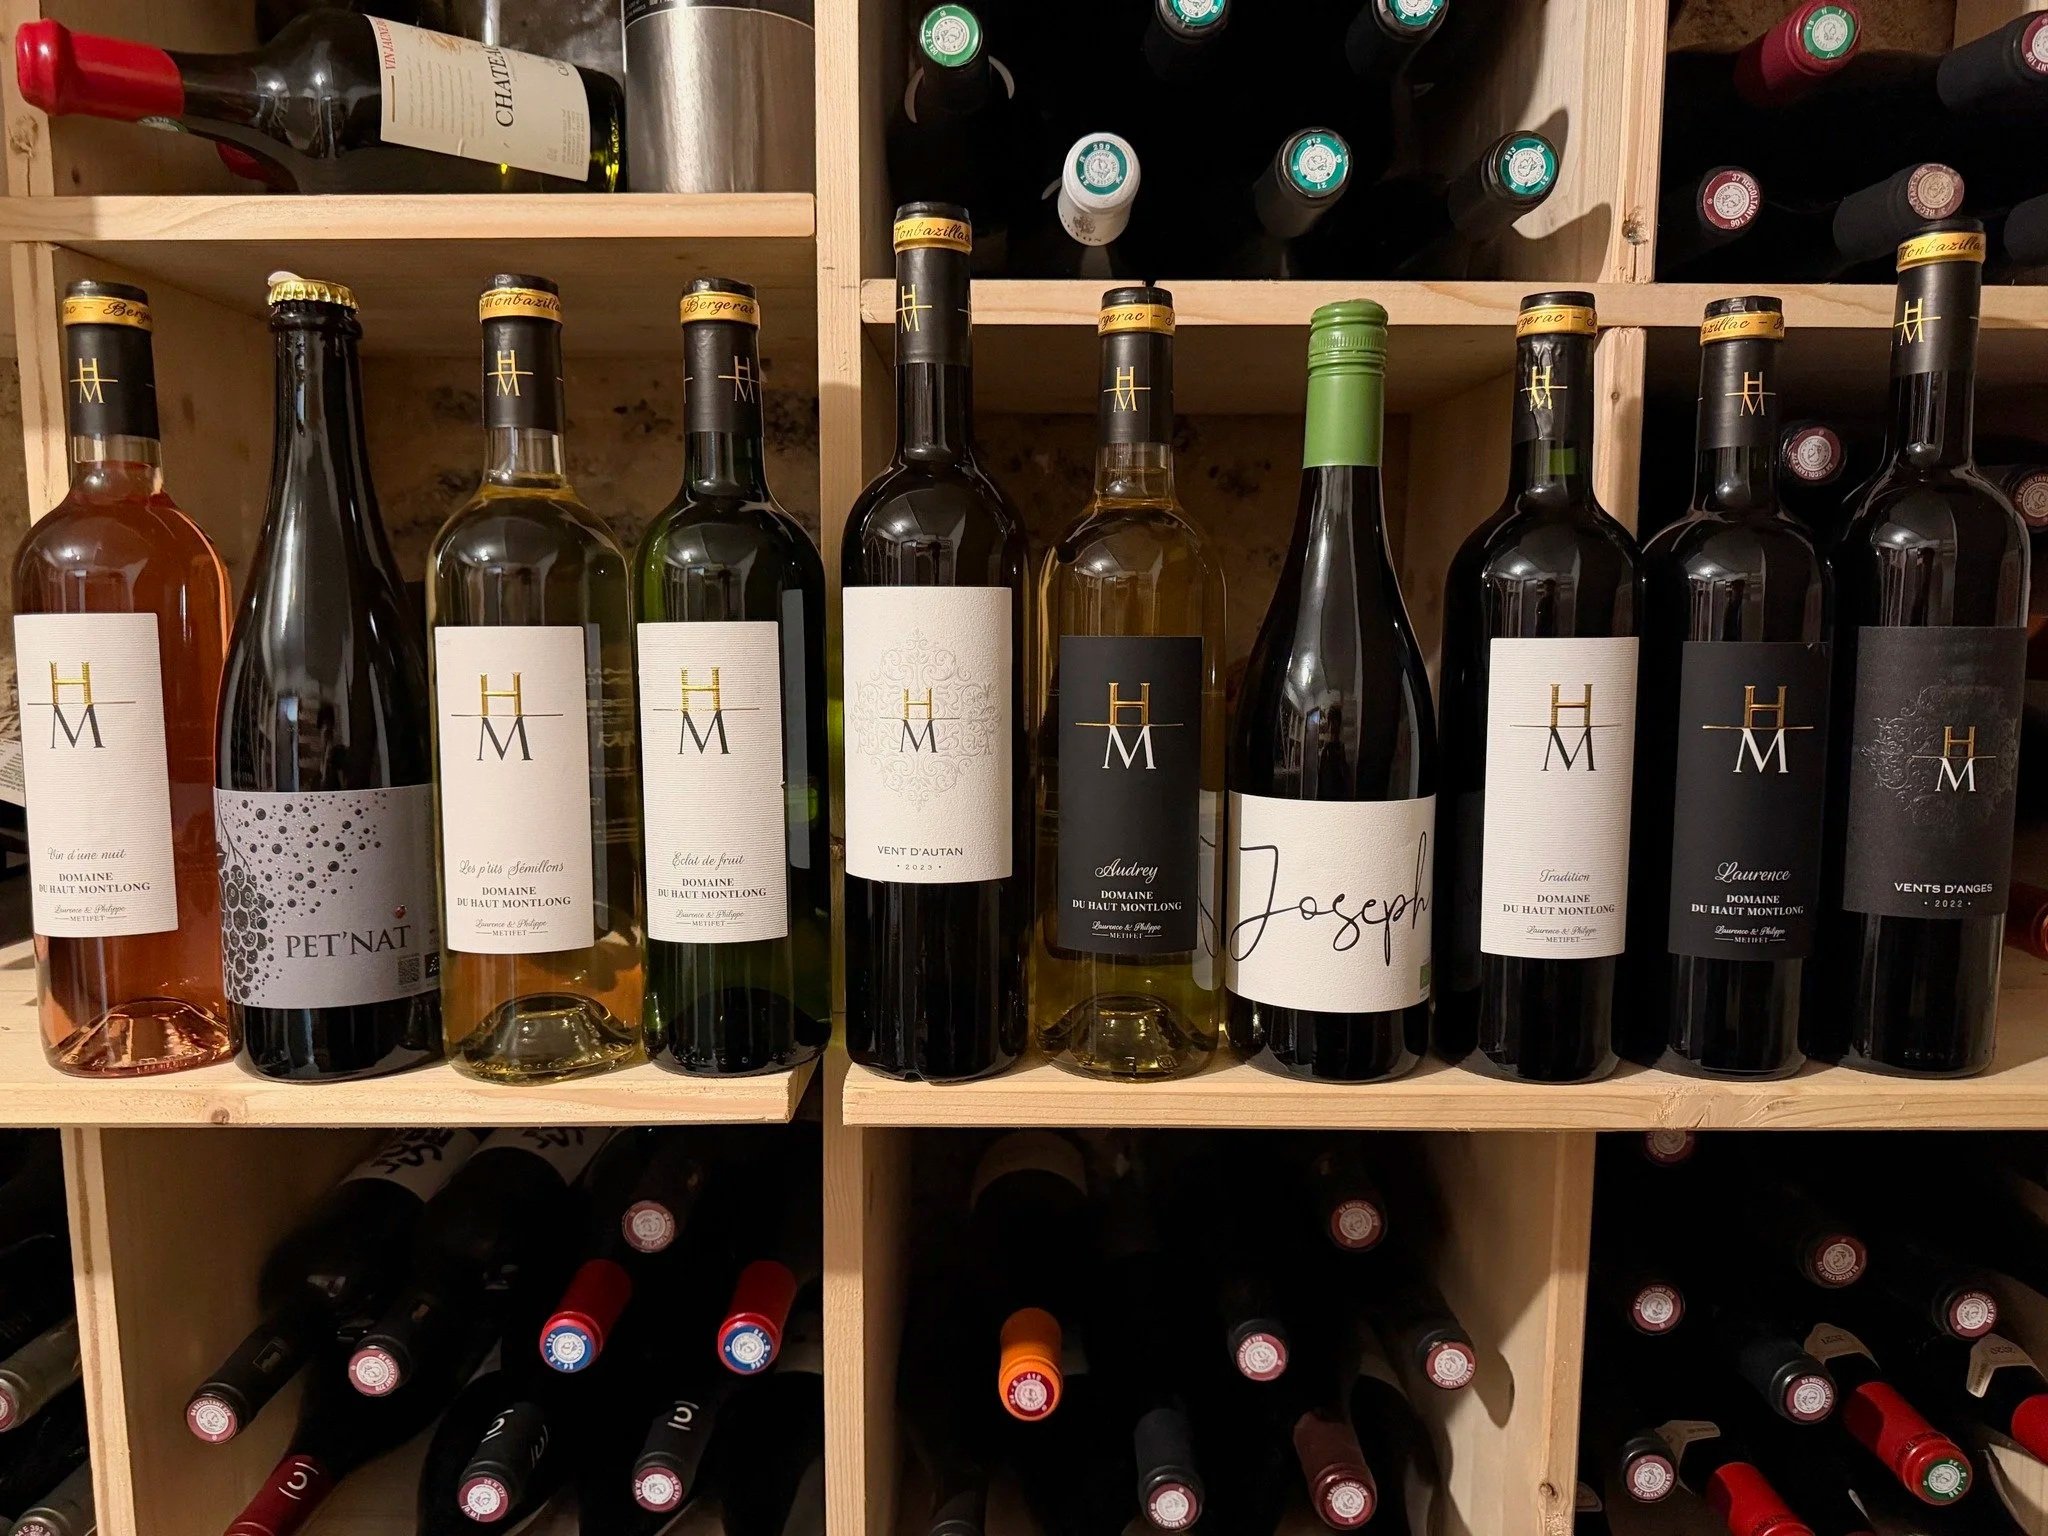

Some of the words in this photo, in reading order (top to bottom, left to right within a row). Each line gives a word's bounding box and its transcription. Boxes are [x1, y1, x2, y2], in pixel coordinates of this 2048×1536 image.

[1740, 177, 1758, 221] RECOLTANT
[685, 296, 755, 316] Bergerac
[101, 848, 126, 860] nuit
[877, 845, 906, 857] VENT
[910, 846, 964, 857] D'AUTAN
[459, 859, 476, 875] Les
[702, 855, 716, 866] de
[715, 852, 746, 870] fruit
[905, 863, 934, 871] 2023
[59, 872, 114, 882] DOMAINE
[1094, 858, 1159, 884] Audrey
[1539, 868, 1590, 883] Tradition
[1714, 861, 1791, 883] Laurence
[39, 884, 47, 893] DU
[49, 884, 76, 894] HAUT
[78, 881, 151, 894] MONTLONG
[682, 878, 734, 887] DOMAINE
[1894, 882, 1941, 893] VENTS
[1944, 883, 1993, 893] D'ANGES
[482, 886, 537, 896] DOMAINE
[658, 888, 669, 897] DU
[671, 890, 699, 899] HAUT
[702, 887, 767, 899] MONTLONG
[1100, 890, 1154, 900] DOMAINE
[457, 897, 469, 906] DU
[471, 898, 499, 909] HAUT
[502, 896, 571, 908] MONTLONG
[1230, 831, 1431, 967] Joseph
[1536, 894, 1591, 903] DOMAINE
[1726, 894, 1780, 904] DOMAINE
[1934, 899, 1964, 908] 2022
[1072, 899, 1086, 909] DU
[1088, 901, 1118, 911] HAUT
[1120, 901, 1182, 912] MONTLONG
[1502, 903, 1519, 913] DU
[1521, 905, 1555, 915] HAUT
[1557, 903, 1616, 915] MONTLONG
[1691, 903, 1708, 914] DU
[1711, 905, 1744, 916] HAUT
[1747, 905, 1804, 916] MONTLONG
[284, 925, 411, 958] PET'NAT
